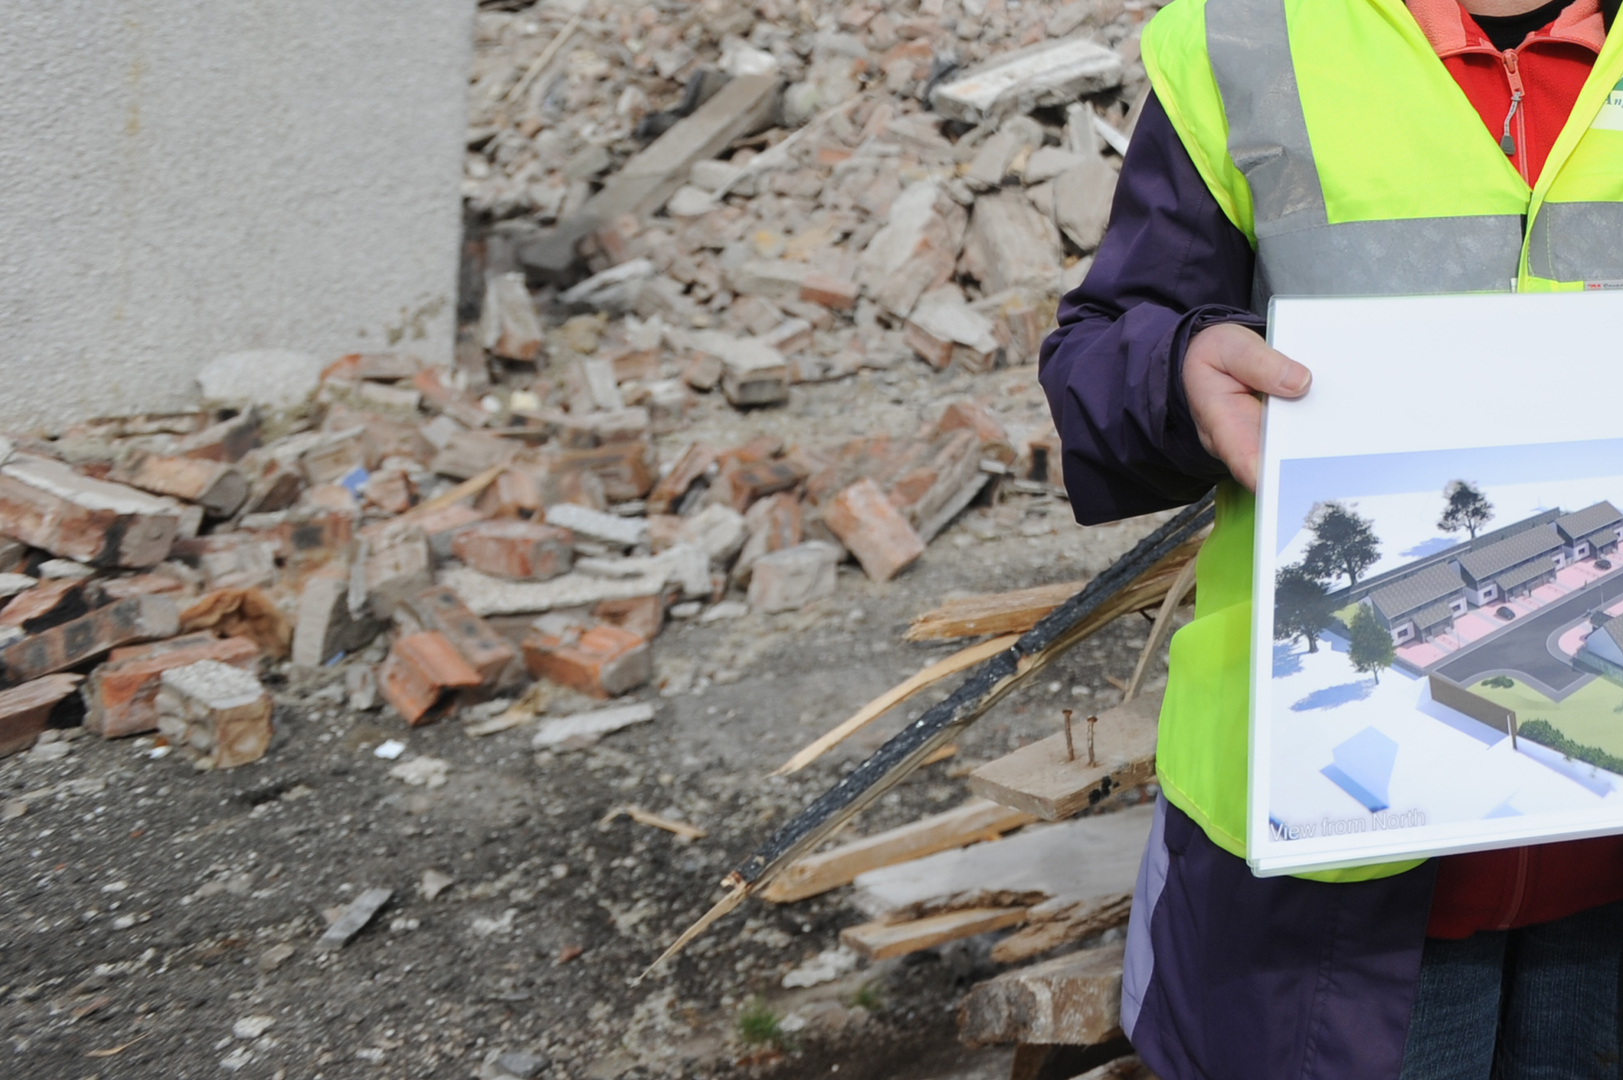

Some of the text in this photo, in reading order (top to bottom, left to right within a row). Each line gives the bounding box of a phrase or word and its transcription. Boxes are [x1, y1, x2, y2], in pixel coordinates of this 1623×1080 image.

[1269, 809, 1426, 841] View from North
